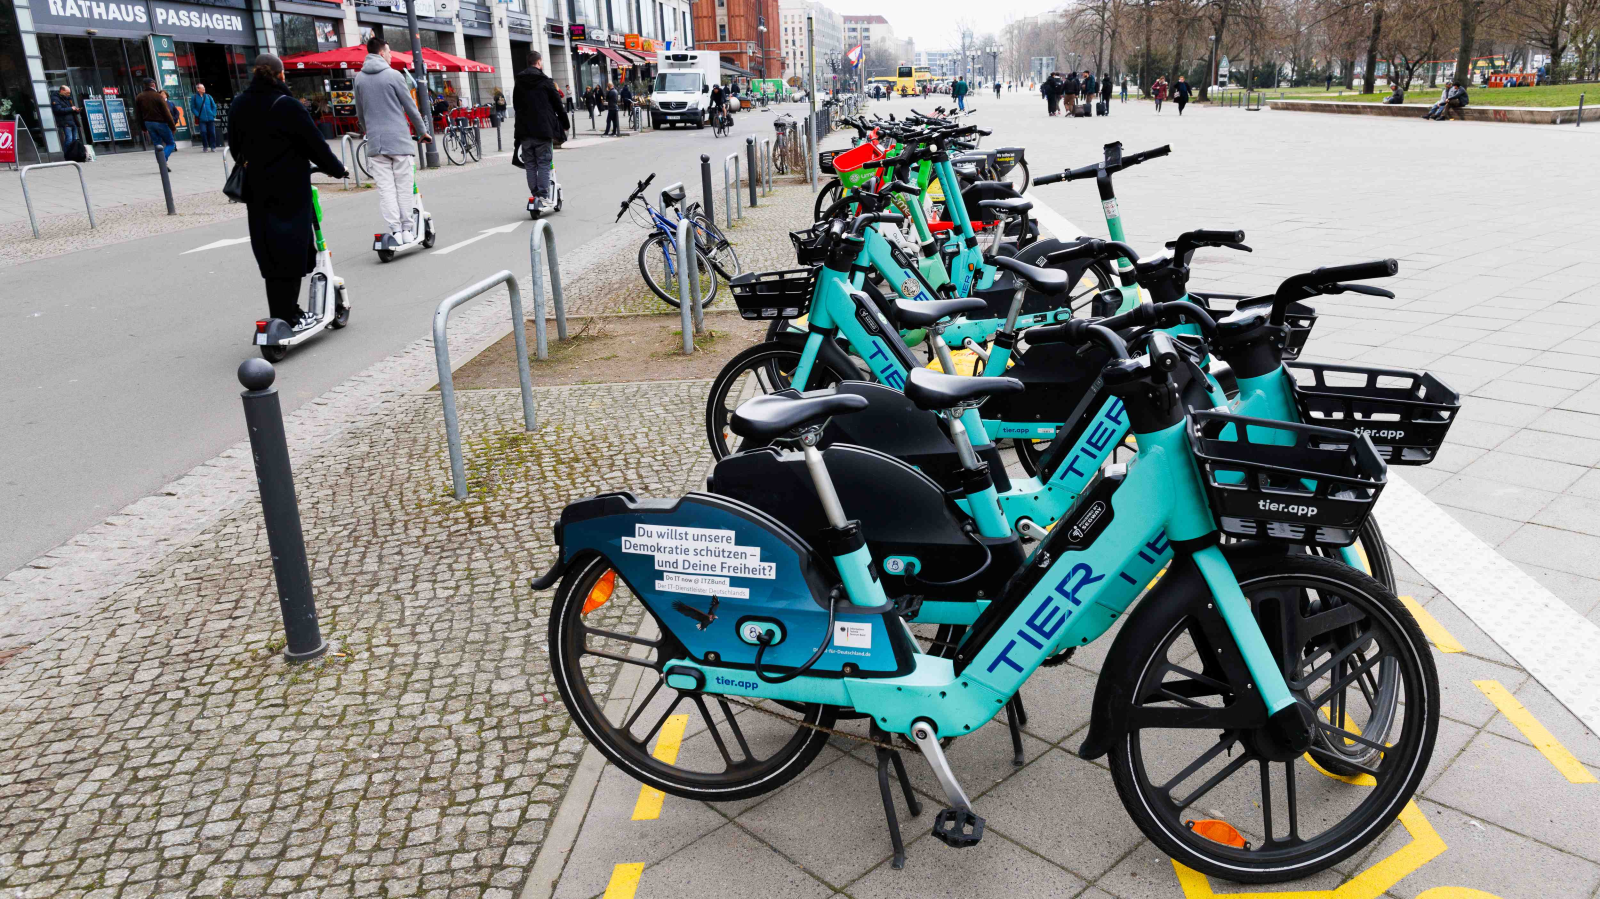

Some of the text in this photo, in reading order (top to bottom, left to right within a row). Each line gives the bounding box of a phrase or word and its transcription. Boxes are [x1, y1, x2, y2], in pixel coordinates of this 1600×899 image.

[50, 0, 242, 31] RATHAUS PASSAGEN
[868, 340, 906, 390] TIE
[1081, 506, 1102, 530] SEGWAY
[1258, 499, 1318, 517] tier.app
[637, 526, 732, 544] Du willst unsere
[624, 540, 690, 556] Demokratie
[693, 546, 747, 560] schützen
[657, 557, 773, 577] und Deine Freiheit?
[667, 583, 707, 593] IT-Dienstleister
[986, 562, 1106, 674] TIER
[715, 675, 759, 691] tier.app
